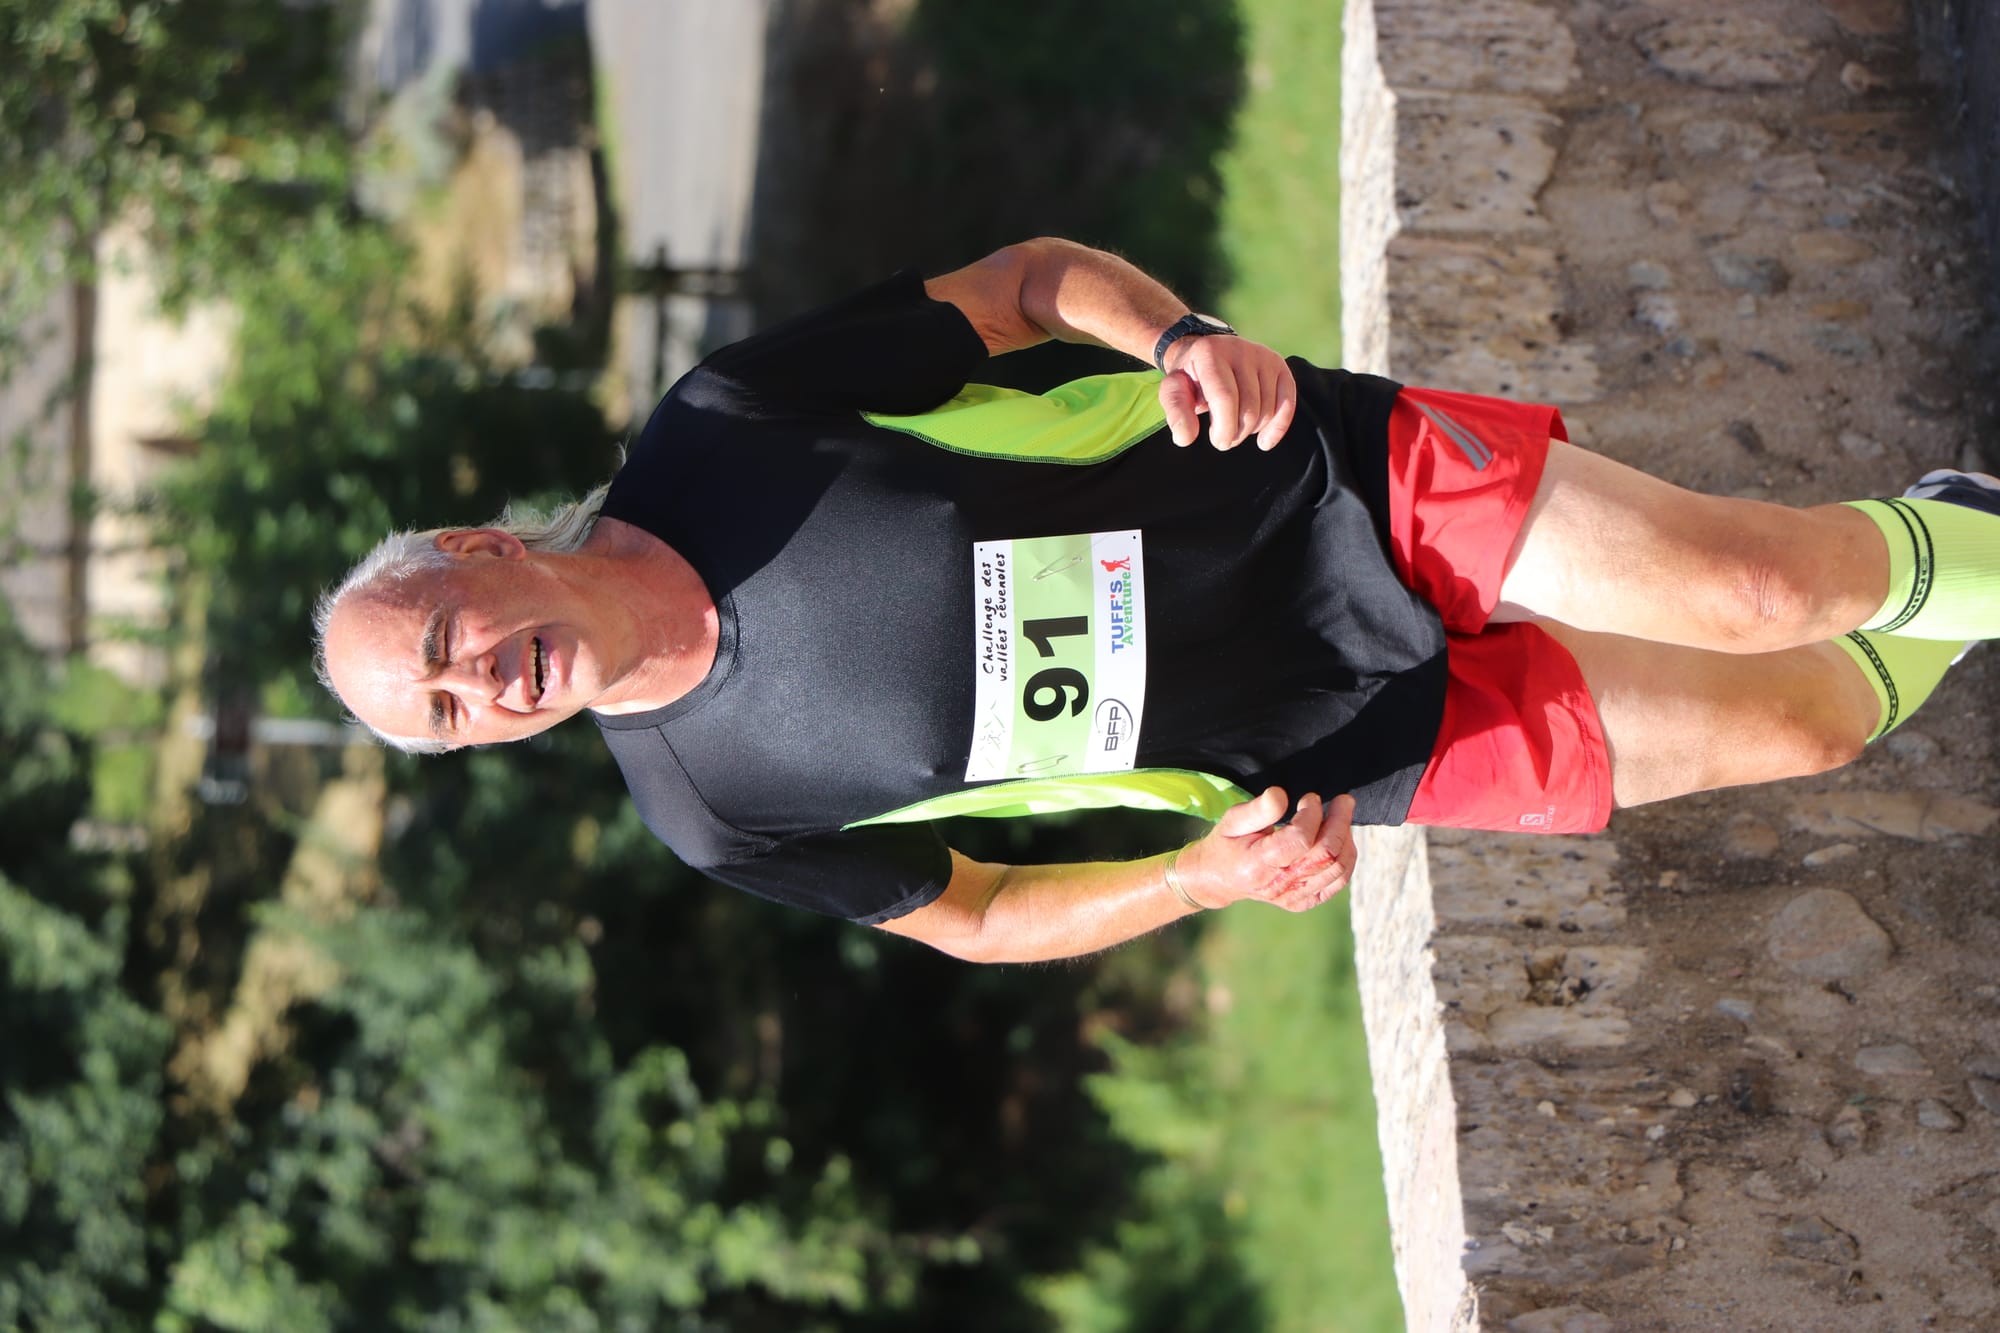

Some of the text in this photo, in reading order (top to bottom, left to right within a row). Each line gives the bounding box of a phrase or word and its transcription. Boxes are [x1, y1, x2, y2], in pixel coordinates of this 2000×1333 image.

[981, 561, 997, 674] Challenge des
[995, 552, 1008, 682] vallées cévenoles
[1110, 579, 1124, 654] TUFF'S
[1120, 570, 1133, 646] Aventure
[1022, 615, 1089, 722] 91
[1104, 706, 1122, 751] BFP
